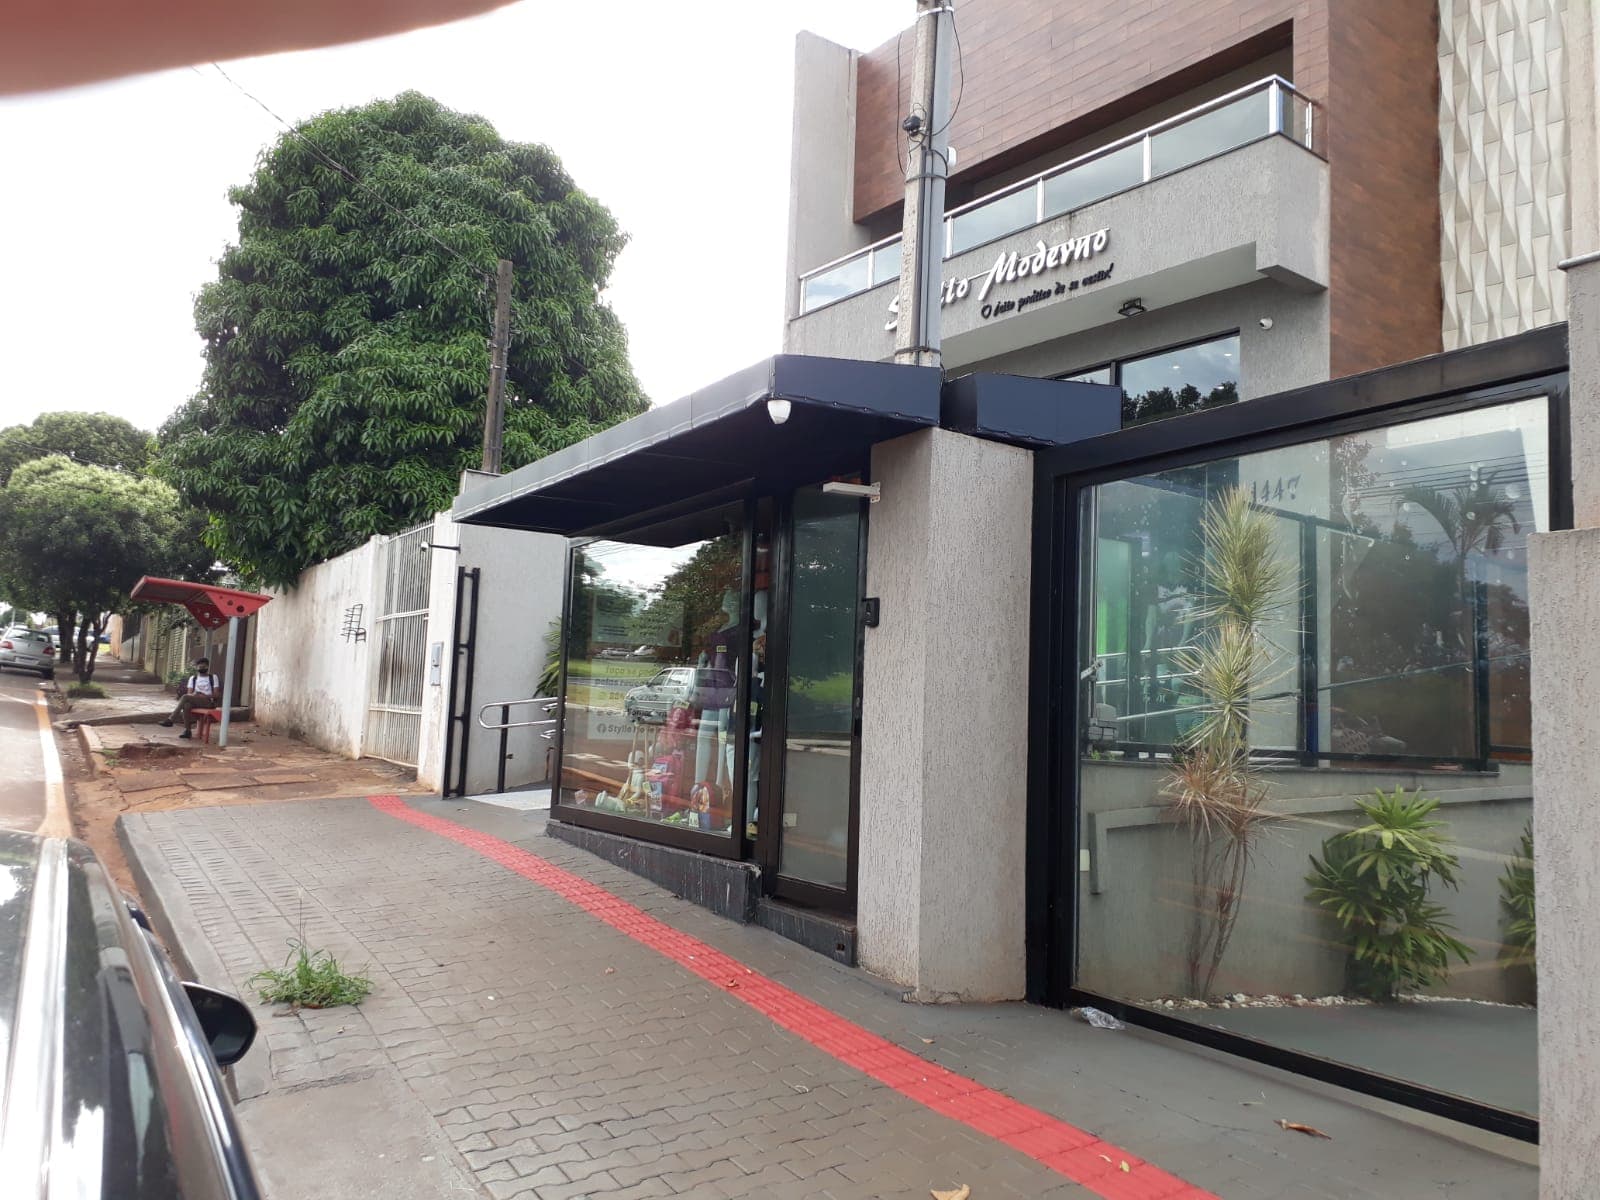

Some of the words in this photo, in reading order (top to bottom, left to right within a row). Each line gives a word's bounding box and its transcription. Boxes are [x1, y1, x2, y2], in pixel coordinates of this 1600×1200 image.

[977, 227, 1110, 301] Moderno
[981, 303, 993, 320] O
[1055, 281, 1066, 296] de
